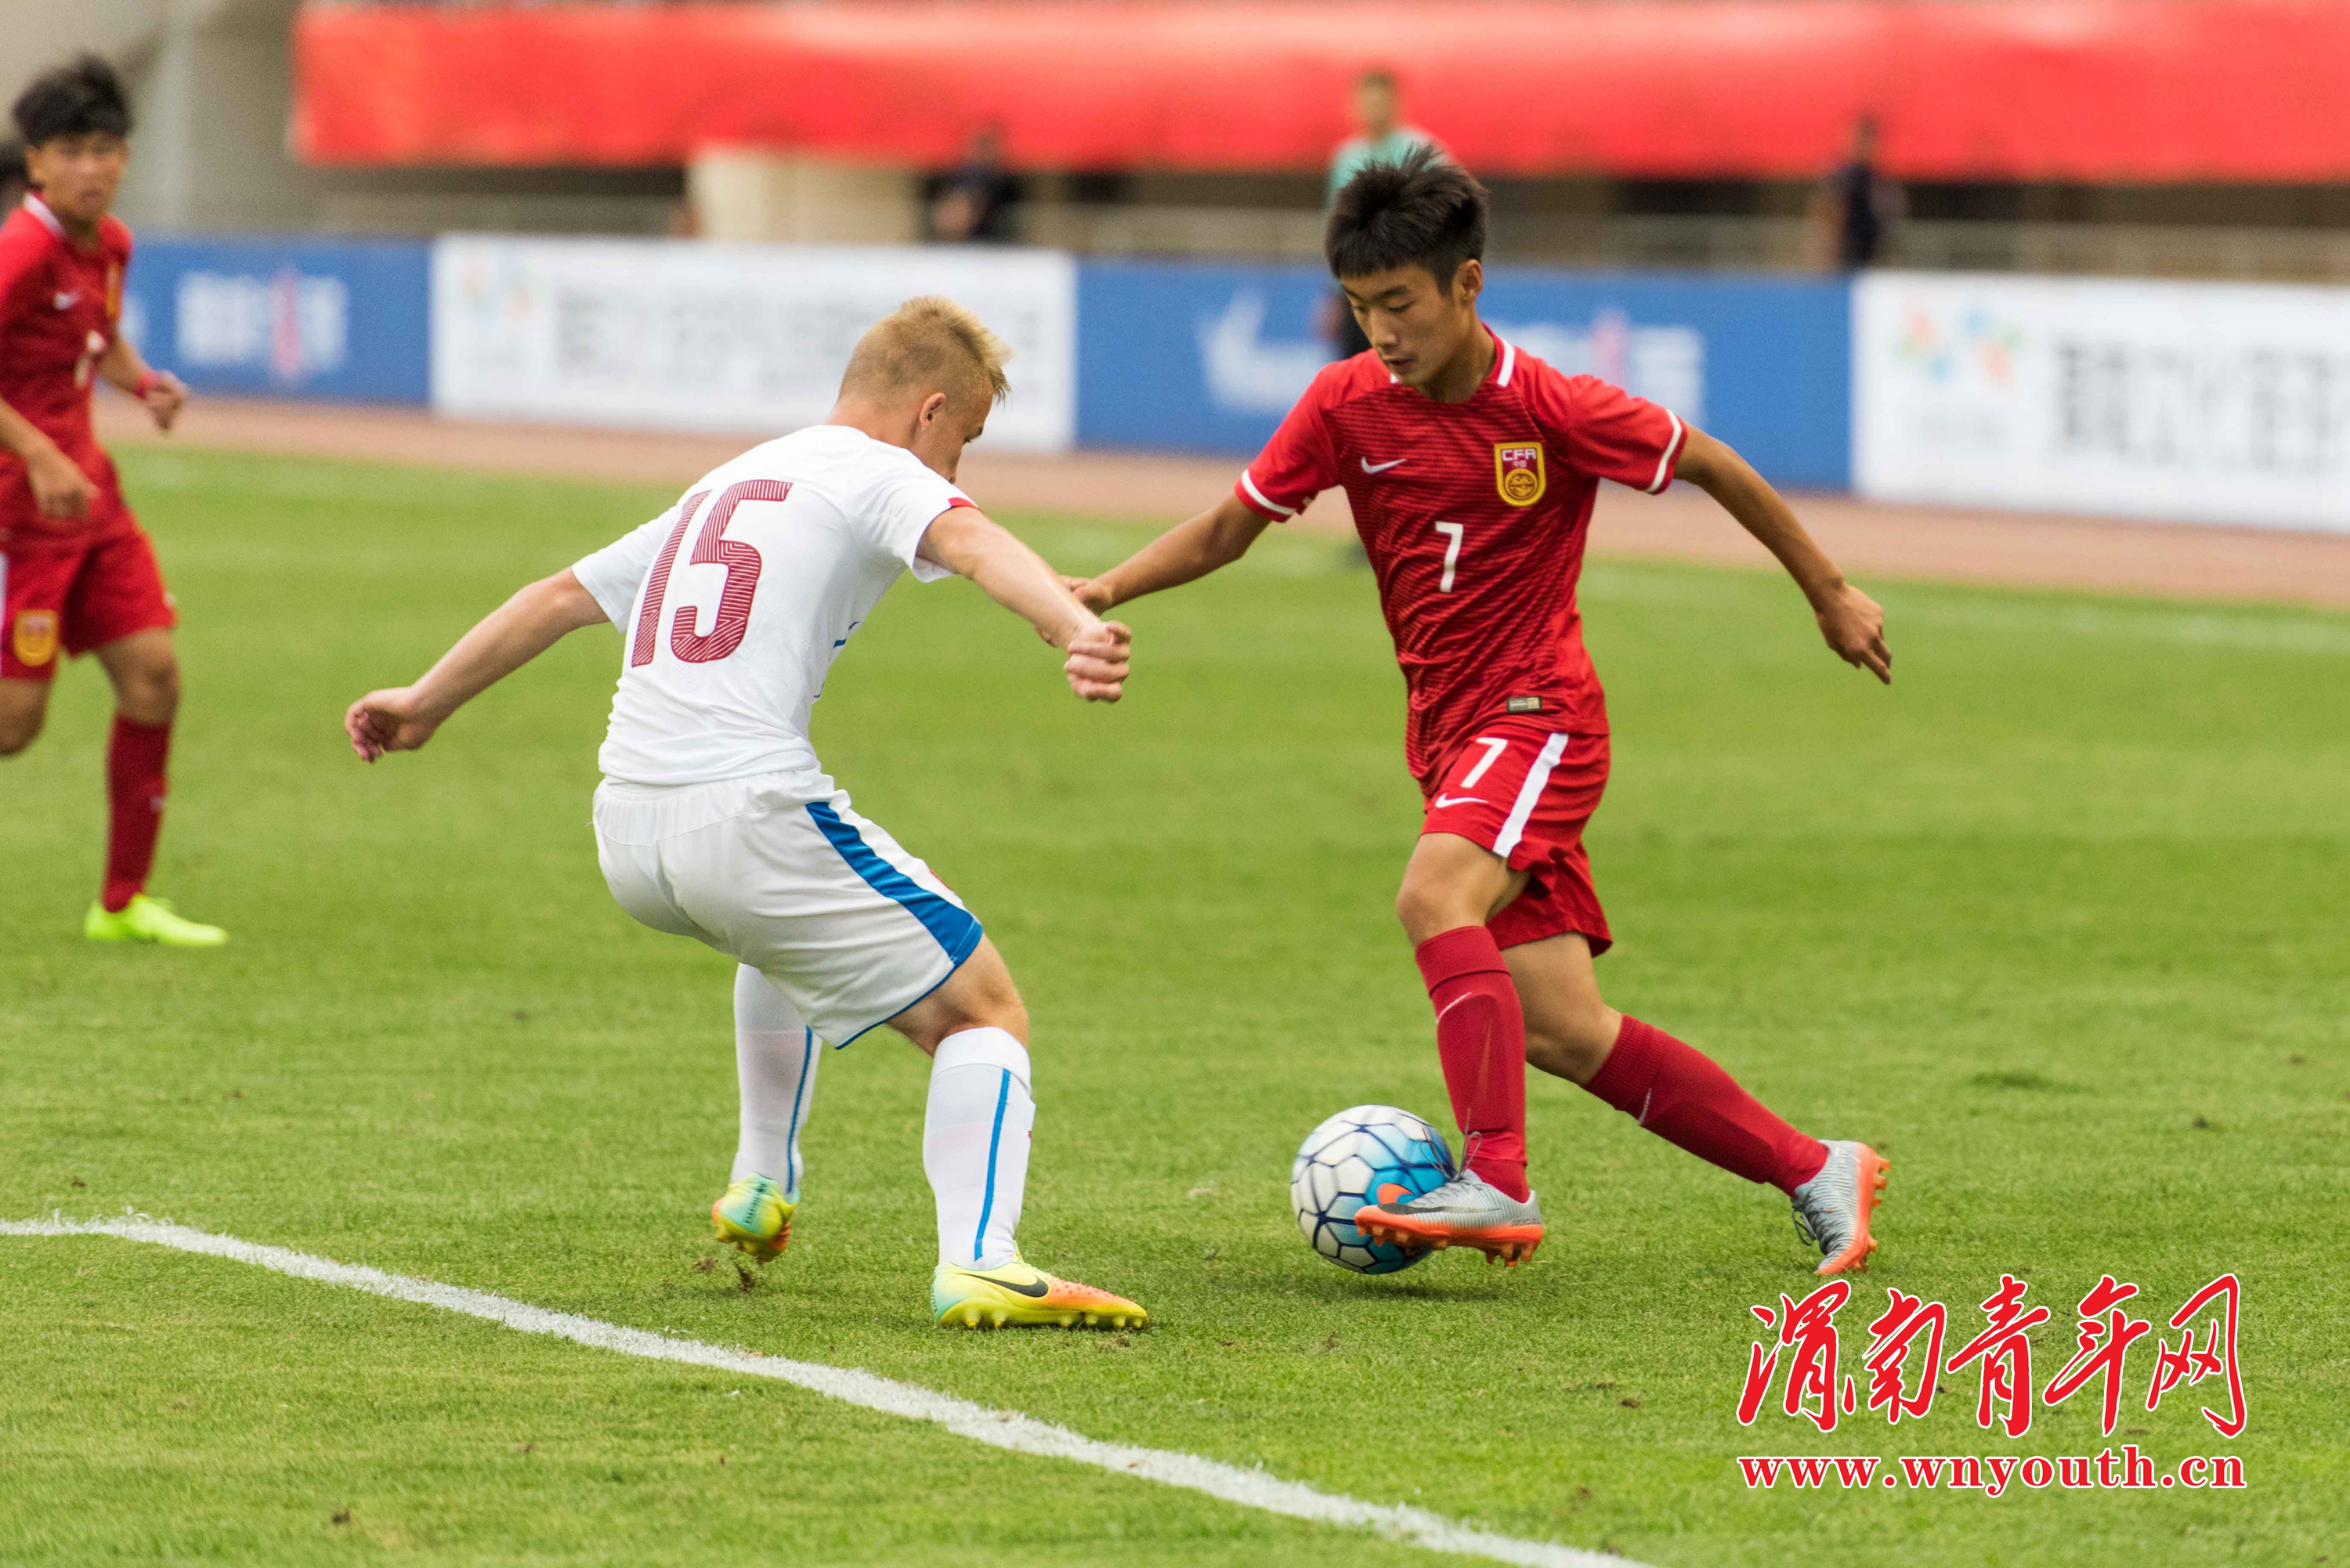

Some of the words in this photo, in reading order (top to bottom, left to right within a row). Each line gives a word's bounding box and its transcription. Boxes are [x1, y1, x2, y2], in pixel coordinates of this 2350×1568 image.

[1502, 448, 1537, 461] CFA
[631, 479, 794, 668] 15
[1435, 521, 1464, 594] 7
[1459, 736, 1509, 789] 7
